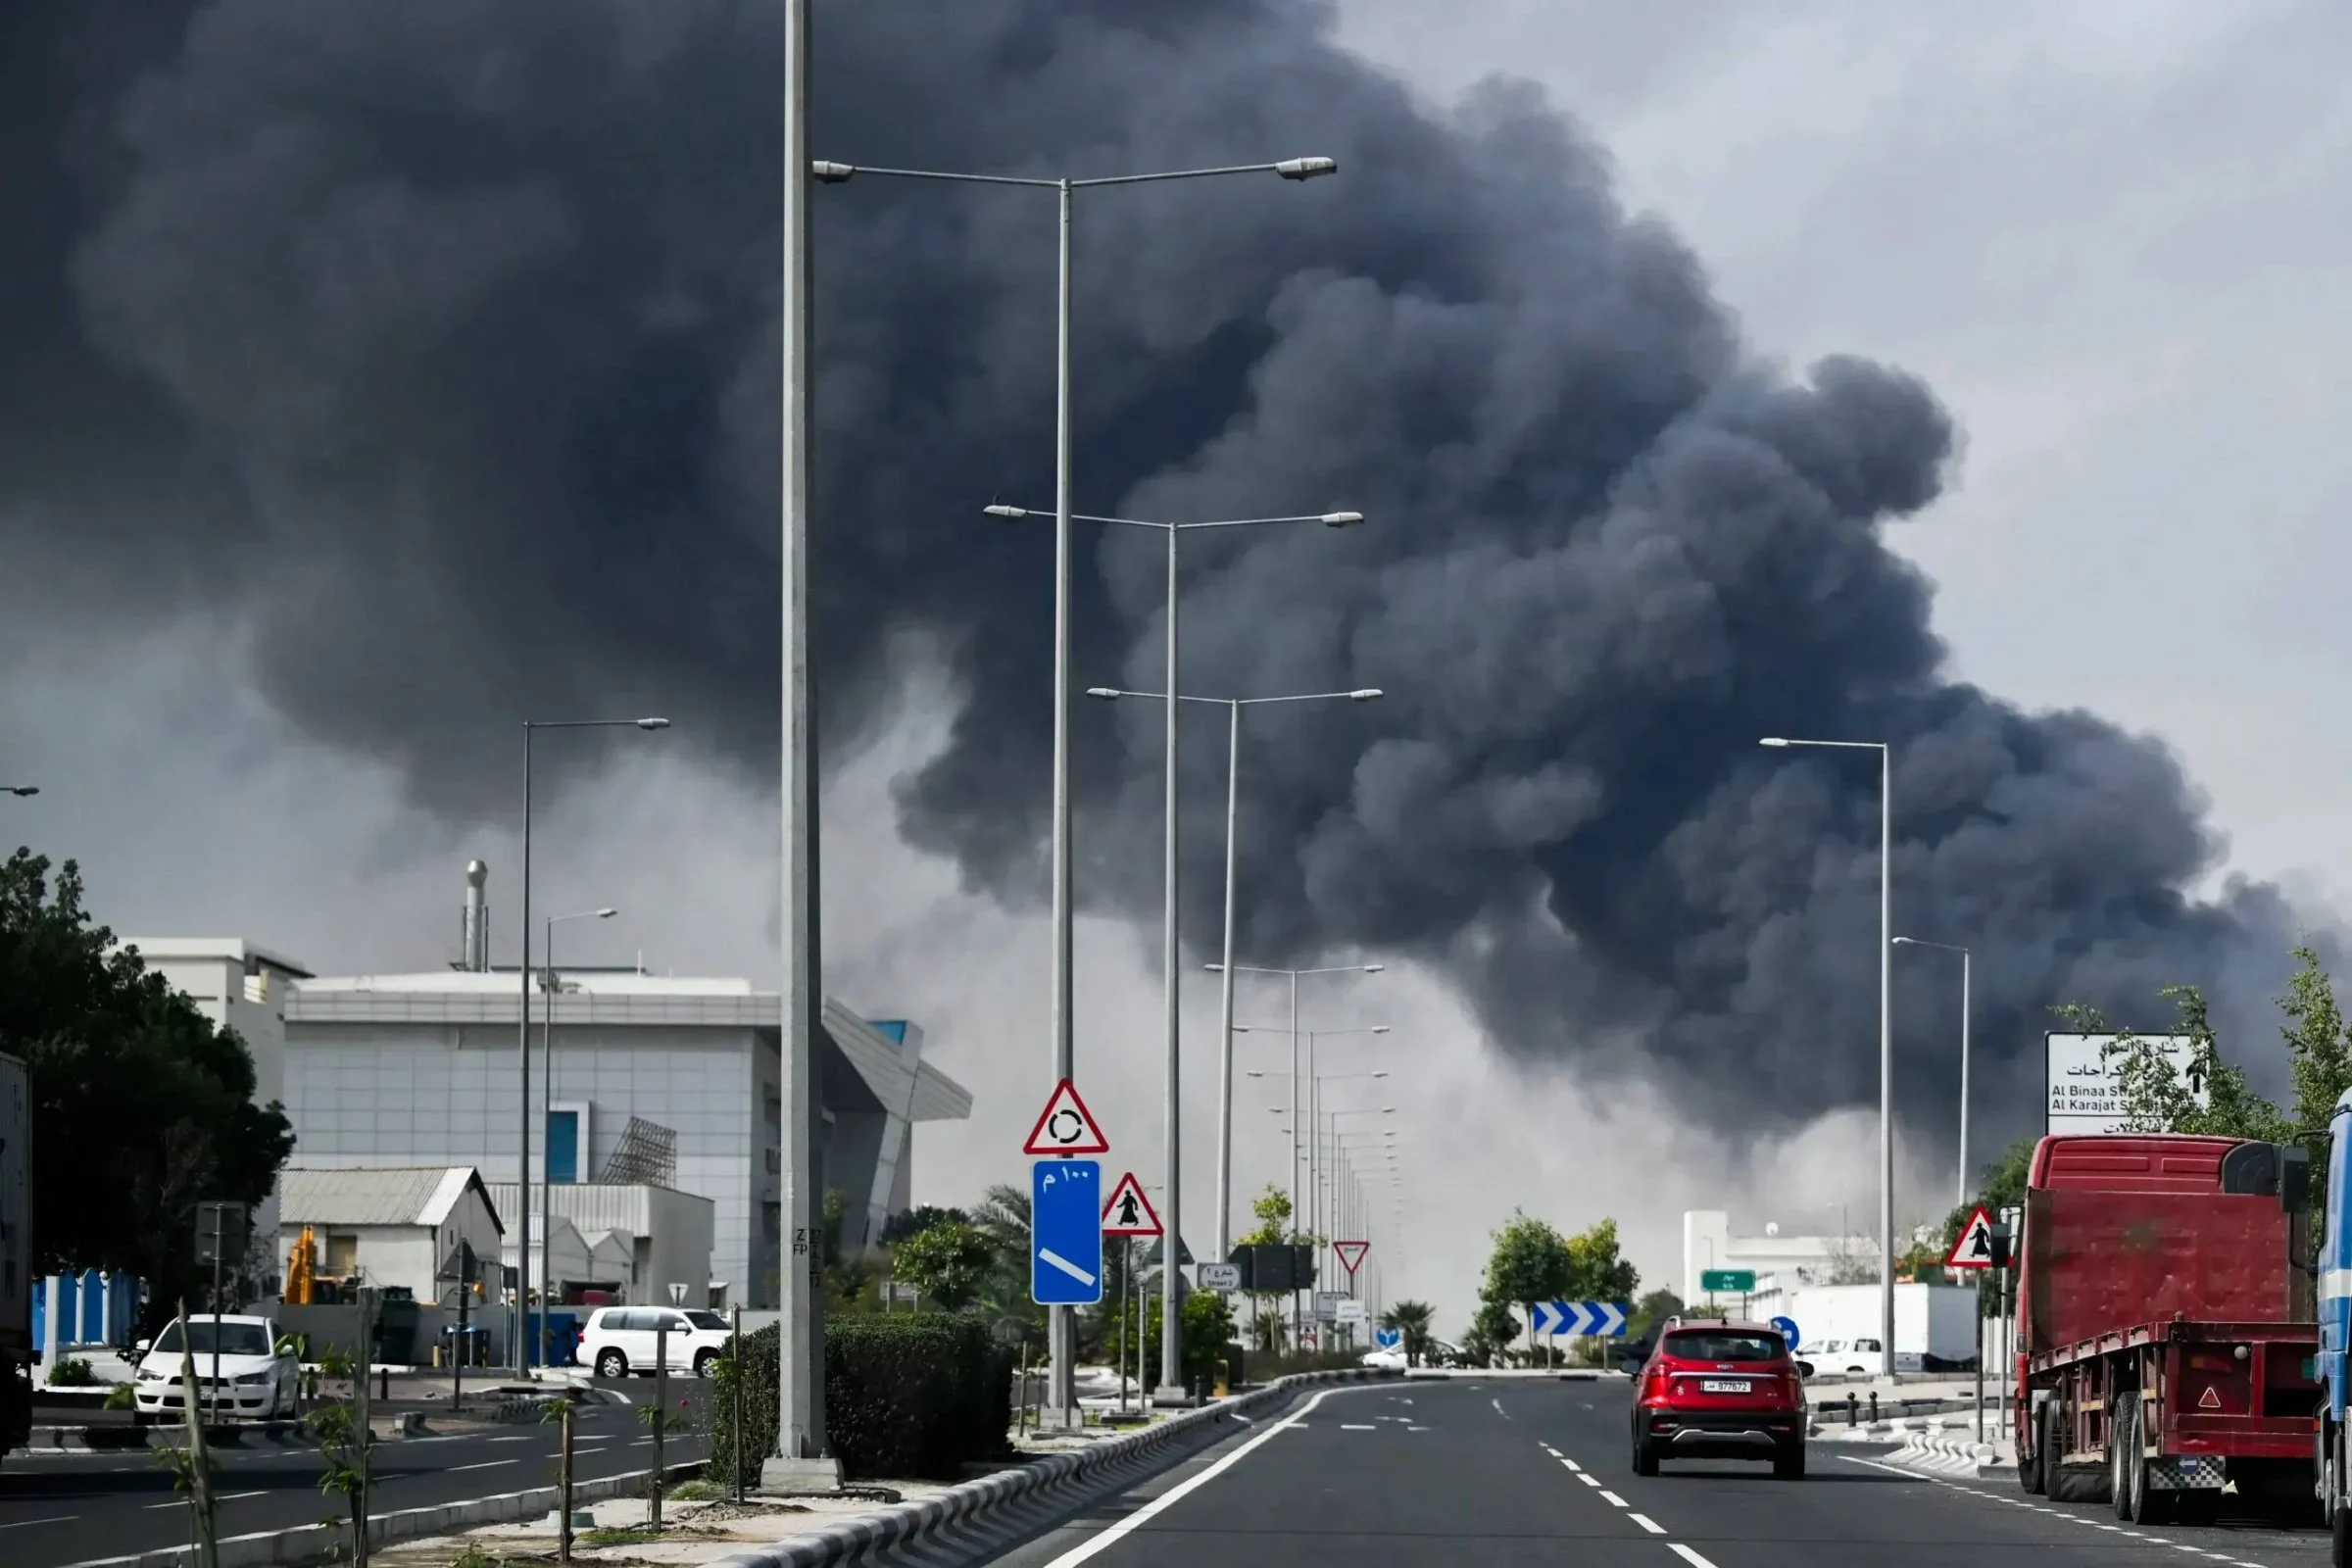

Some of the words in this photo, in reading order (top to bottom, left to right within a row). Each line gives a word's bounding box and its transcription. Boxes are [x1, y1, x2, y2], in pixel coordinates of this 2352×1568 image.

[2052, 1085, 2065, 1097] Al
[2070, 1085, 2105, 1097] Binaa
[2052, 1100, 2065, 1110] Al
[2070, 1100, 2116, 1112] Karajat
[1061, 1165, 1089, 1182] ١٠٠
[1043, 1173, 1056, 1194] م
[797, 1228, 805, 1242] Z
[793, 1244, 808, 1255] FP
[1718, 1382, 1747, 1391] 977672
